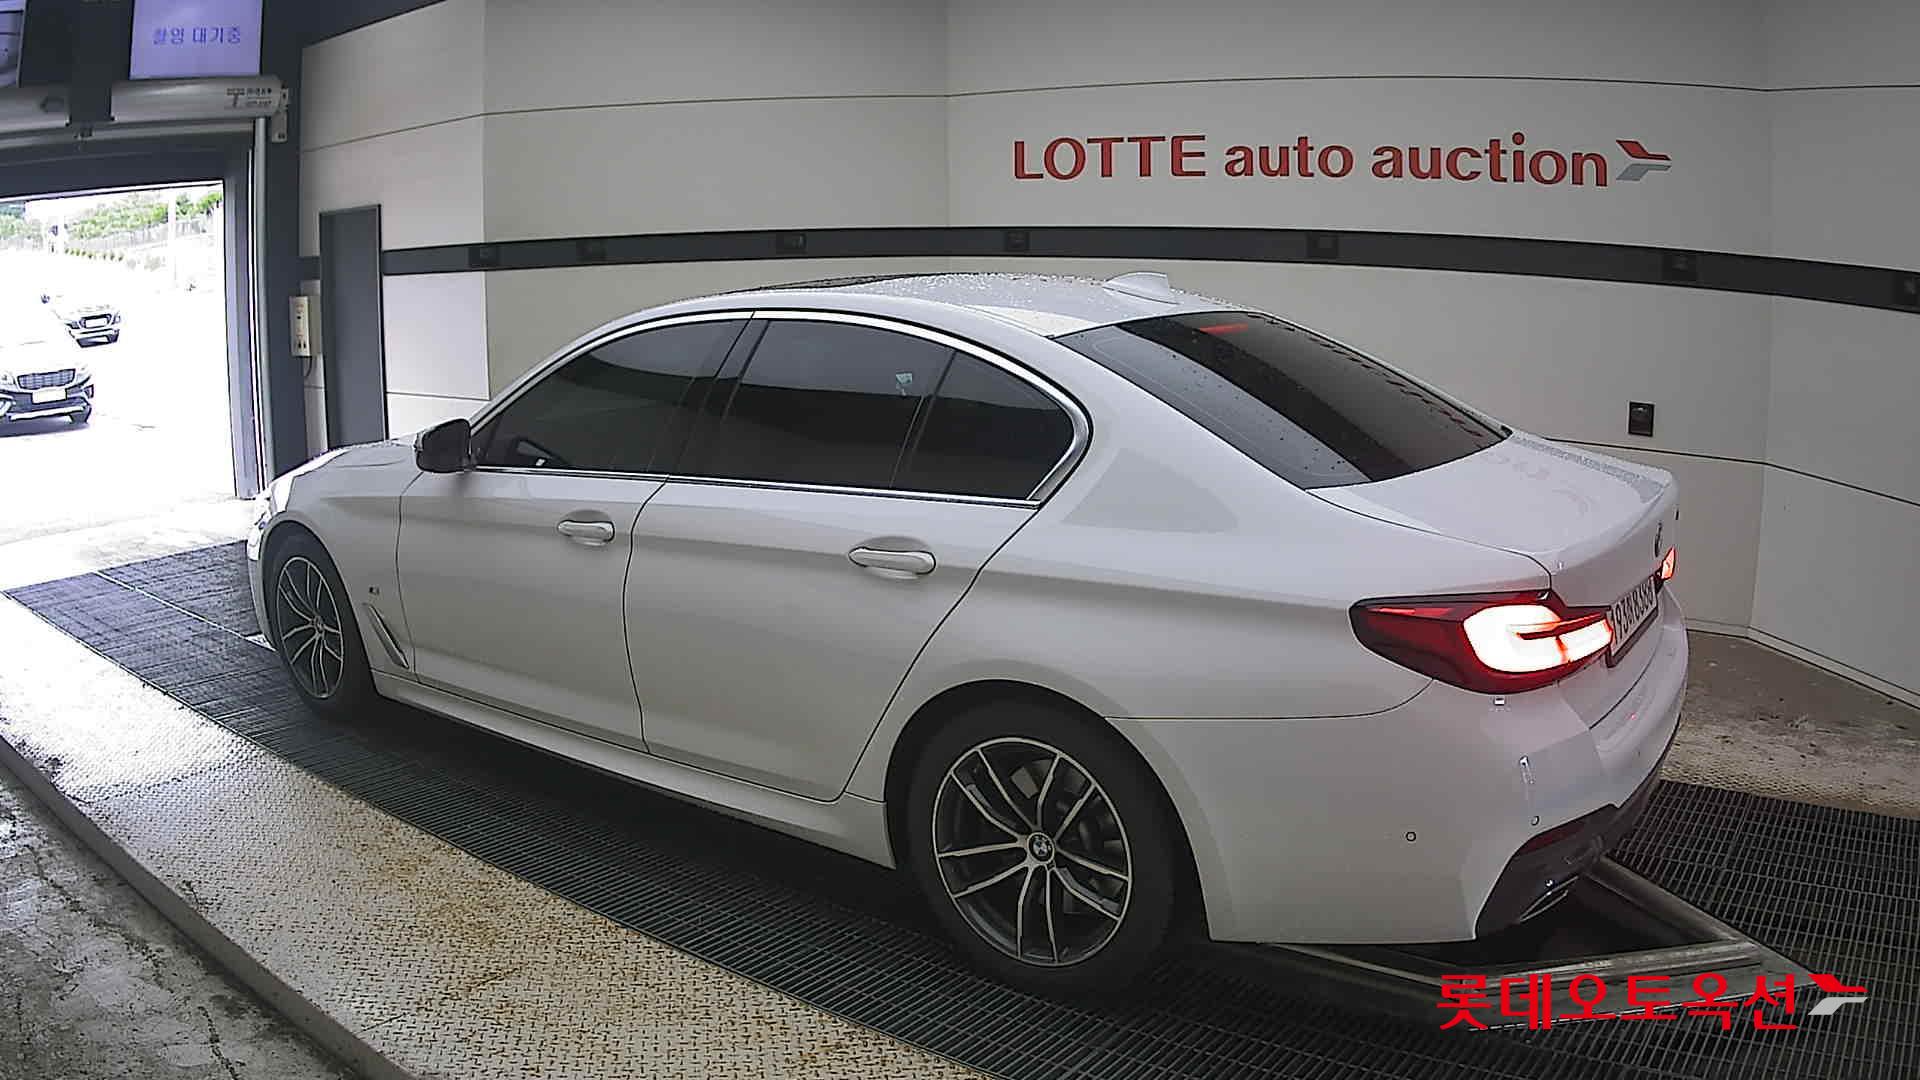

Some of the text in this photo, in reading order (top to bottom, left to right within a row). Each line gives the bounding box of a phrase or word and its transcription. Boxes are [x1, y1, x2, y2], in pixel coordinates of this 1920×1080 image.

[192, 27, 241, 44] 대기중
[1014, 132, 1607, 186] LOTTE auto auction
